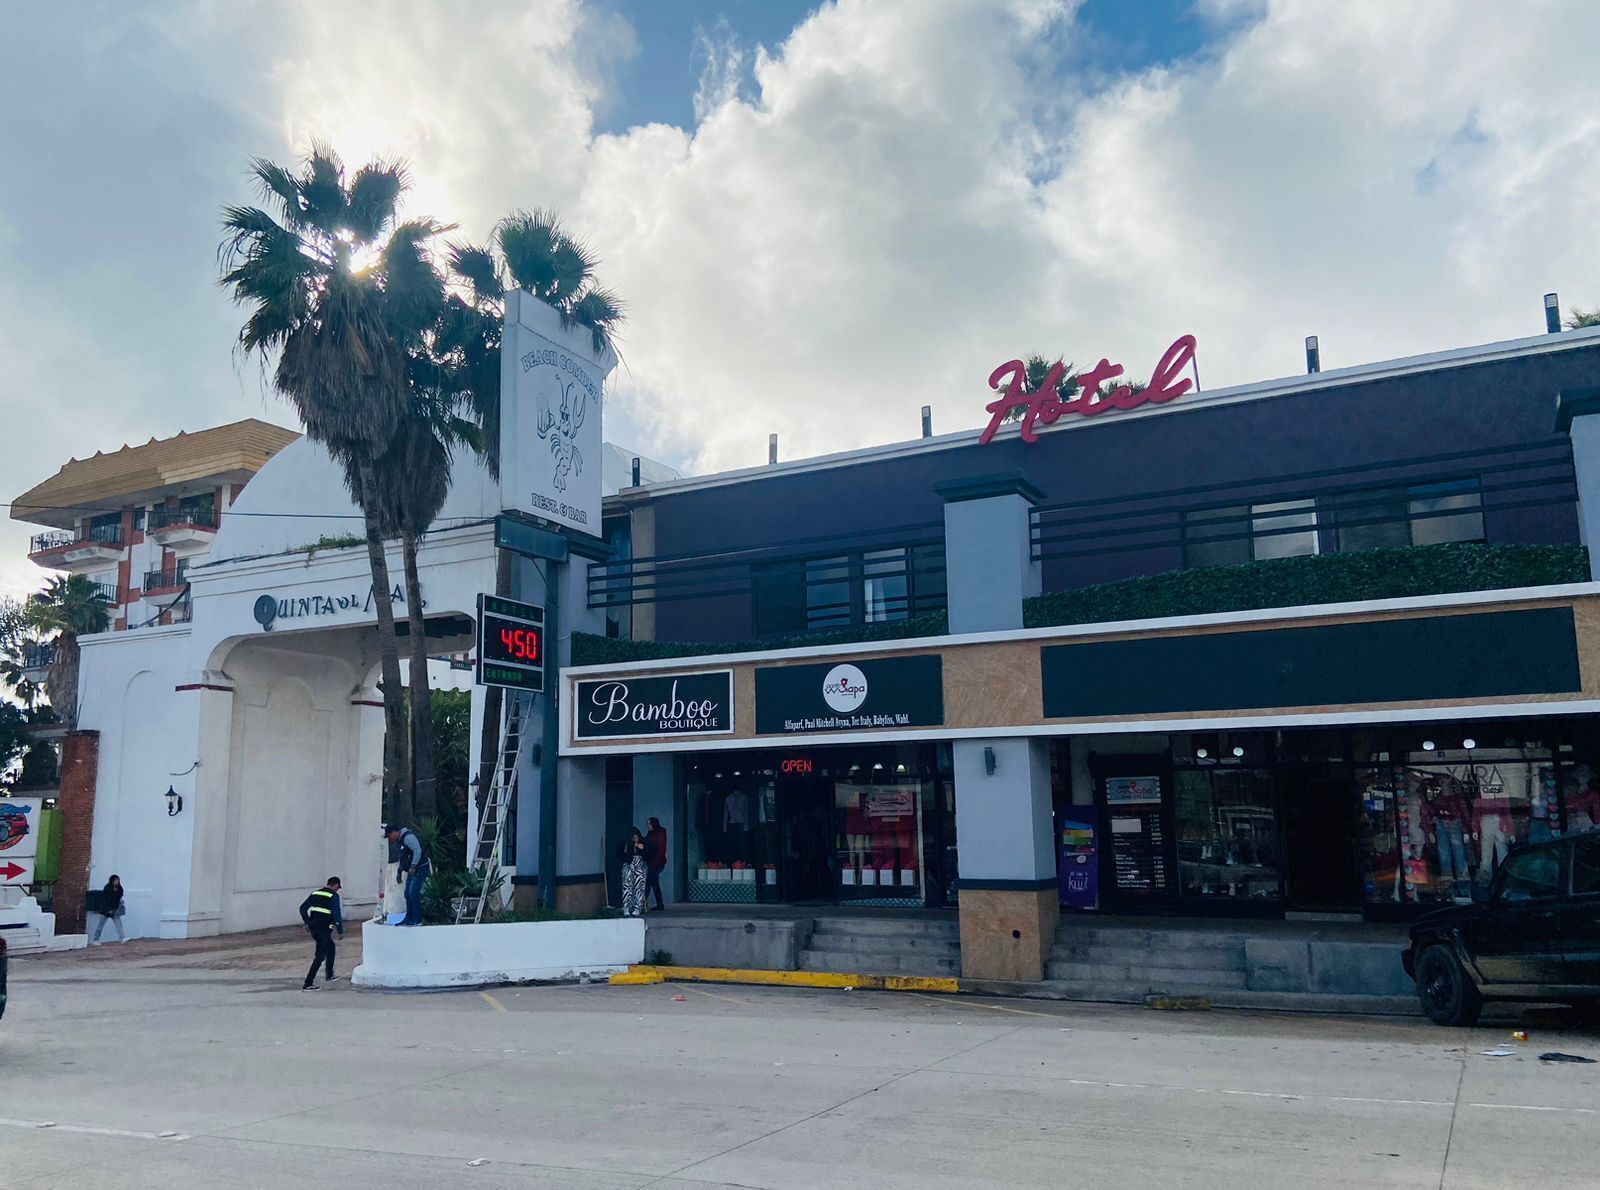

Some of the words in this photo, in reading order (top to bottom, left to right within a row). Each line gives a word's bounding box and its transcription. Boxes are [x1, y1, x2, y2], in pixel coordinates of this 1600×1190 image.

[521, 350, 558, 372] BEACH
[560, 355, 599, 404] COMBER
[979, 334, 1197, 445] Hotel
[531, 493, 558, 514] REST.
[560, 503, 567, 517] &
[568, 506, 587, 524] BAR
[254, 594, 335, 631] QUINTA
[501, 628, 537, 658] 450
[588, 680, 718, 724] Bamboo
[660, 718, 718, 729] BOUTIQUE
[805, 718, 815, 728] Paul
[816, 717, 834, 727] Mitchell
[782, 760, 812, 772] OPEN
[1445, 765, 1504, 786] XARA
